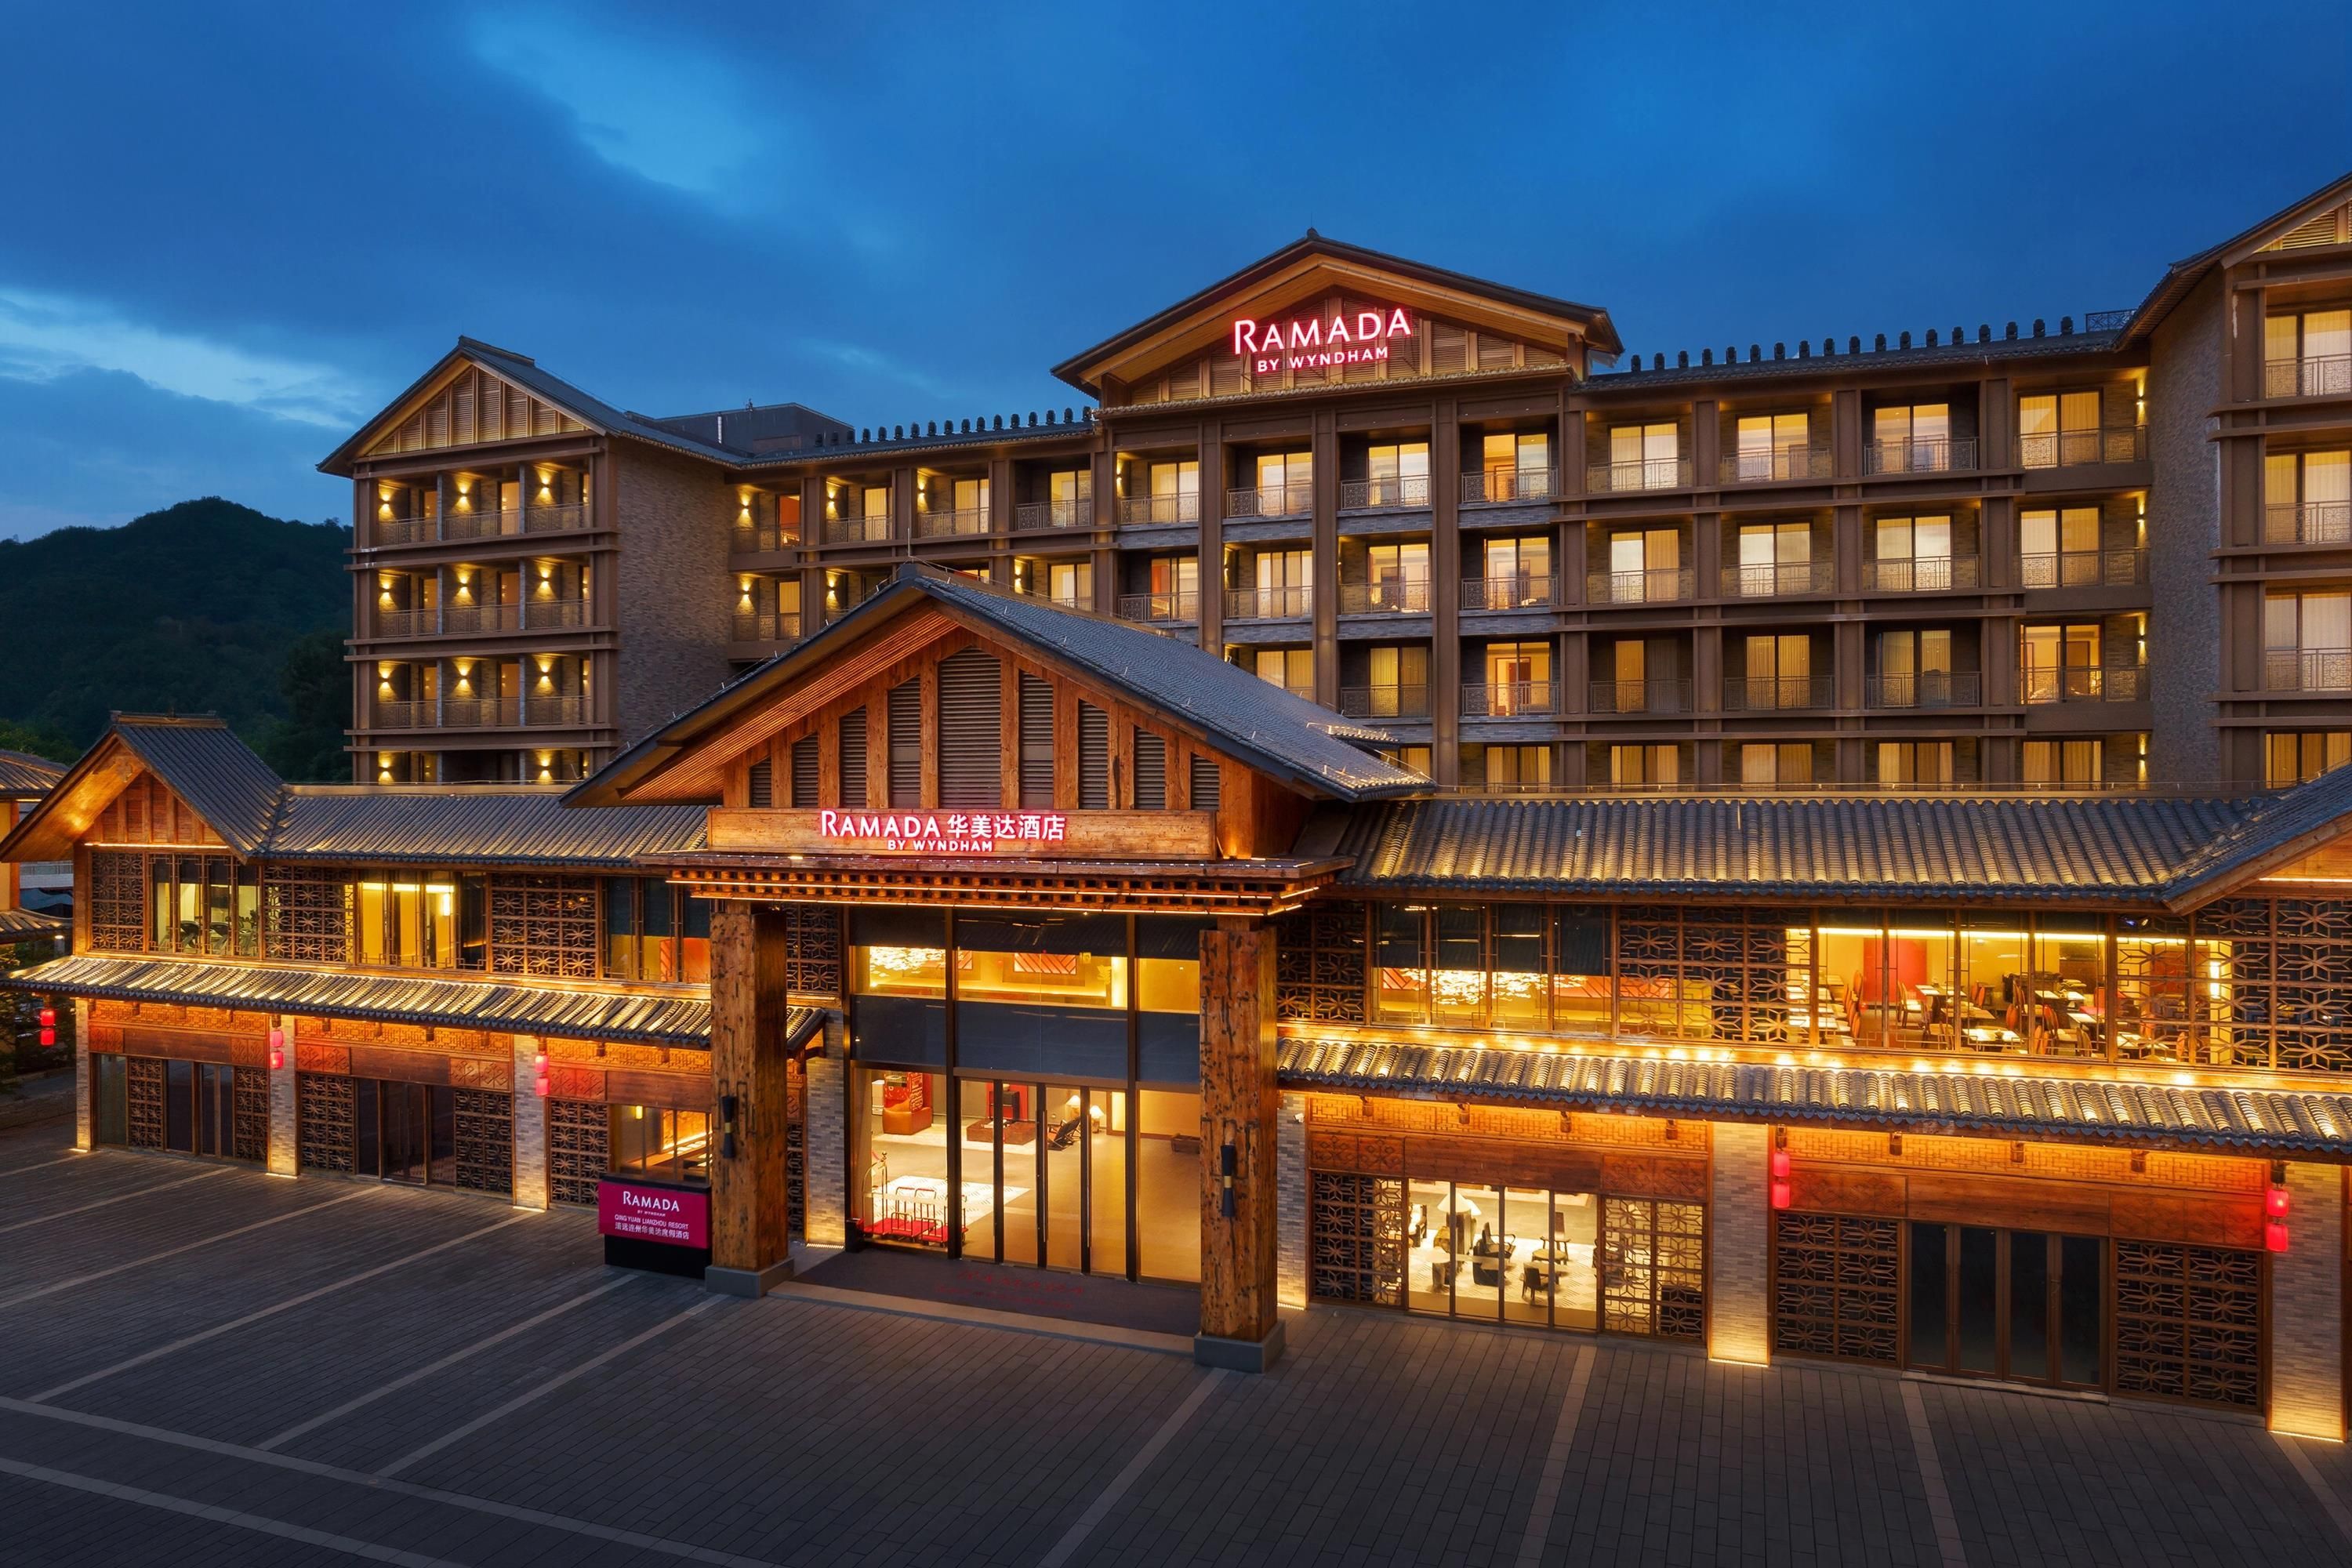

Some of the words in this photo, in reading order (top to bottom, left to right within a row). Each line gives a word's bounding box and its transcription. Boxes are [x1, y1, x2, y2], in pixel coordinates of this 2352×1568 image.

[1235, 308, 1411, 354] RAMADA
[1258, 359, 1279, 372] BY
[1289, 346, 1388, 368] WYNDHAM
[821, 810, 940, 837] RAMADA
[947, 814, 1065, 840] 华美达酒店
[887, 839, 906, 851] BY
[913, 840, 993, 852] WYNDHAM
[623, 1191, 681, 1212] RAMADA
